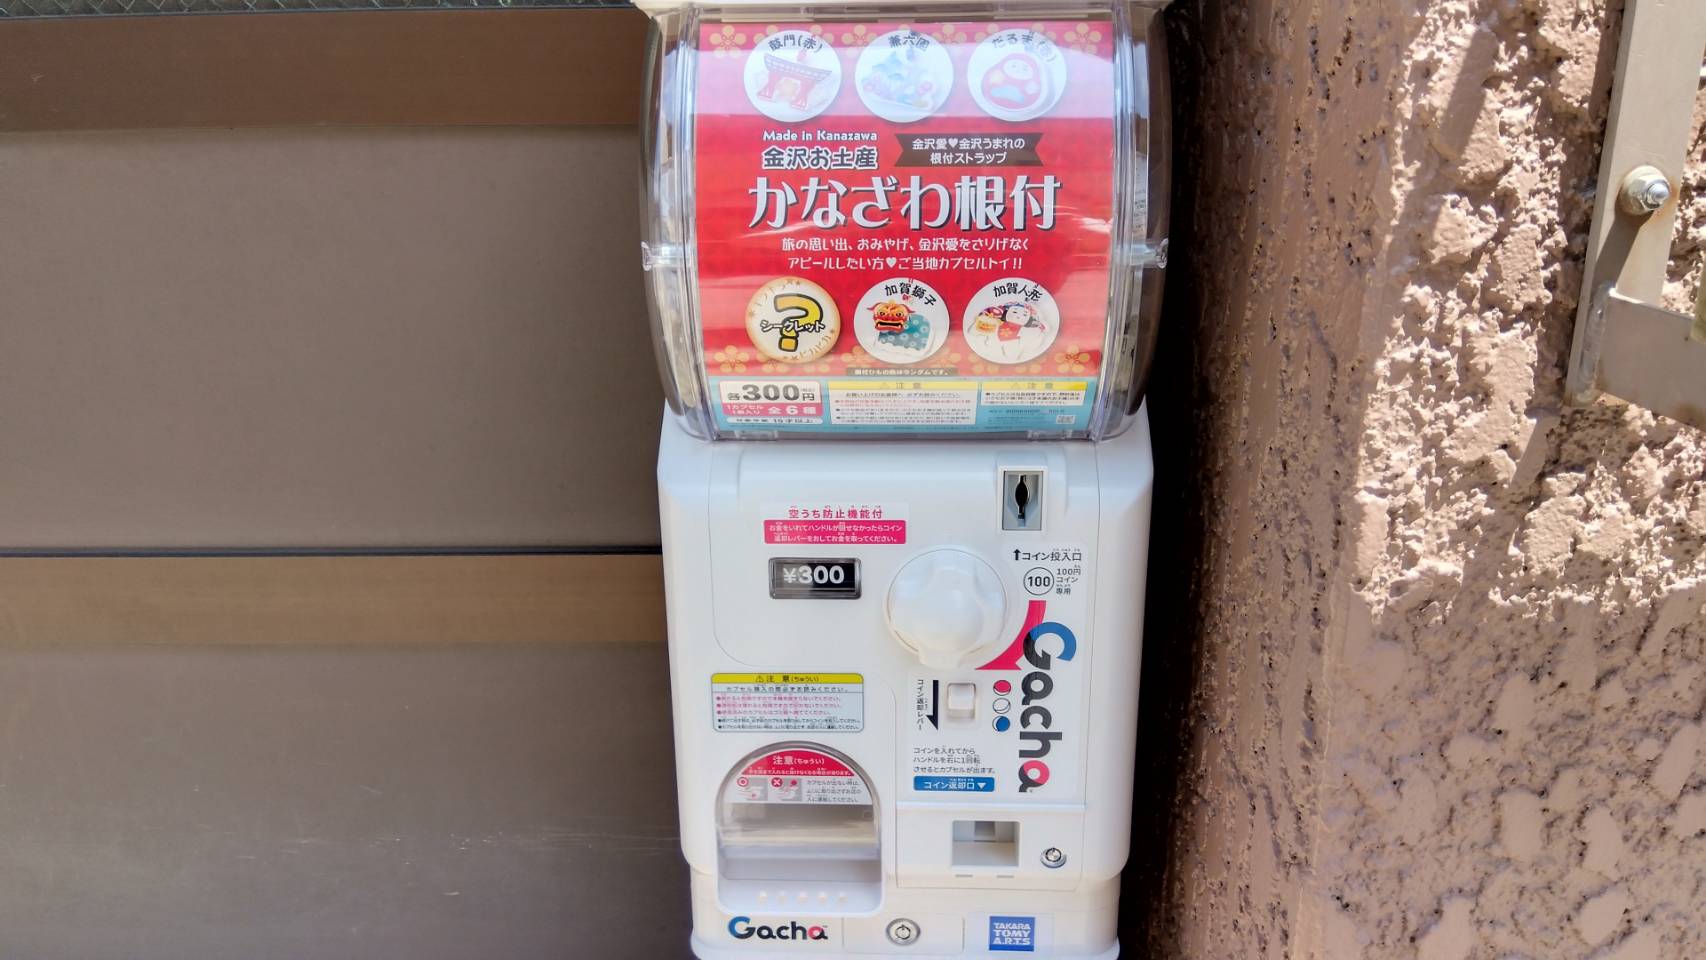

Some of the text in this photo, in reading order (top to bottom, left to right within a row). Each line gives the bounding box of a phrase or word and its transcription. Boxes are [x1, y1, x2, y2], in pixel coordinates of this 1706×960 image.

[763, 130, 877, 142] Made in Kanazawa
[762, 146, 878, 170] 金沢お土産
[930, 152, 1006, 164] 根付ストラップ
[748, 174, 1061, 231] かなざわ根付
[782, 237, 1028, 252] 旅の思い出、おみやげ、金沢愛をさりげなく
[885, 282, 937, 306] 加賀獅子
[993, 282, 1043, 302] 加賀人形
[760, 319, 826, 333] シークレット
[788, 508, 883, 519] 空うち防止機能付
[1022, 552, 1082, 561] コイン投入口
[783, 565, 845, 584] ¥300
[1027, 576, 1051, 588] 100
[1018, 621, 1077, 792] Gacha
[923, 781, 975, 790] コイン返却口
[728, 916, 828, 940] Gacha
[993, 922, 1031, 930] TAKARA
[993, 929, 1031, 937] TOMY
